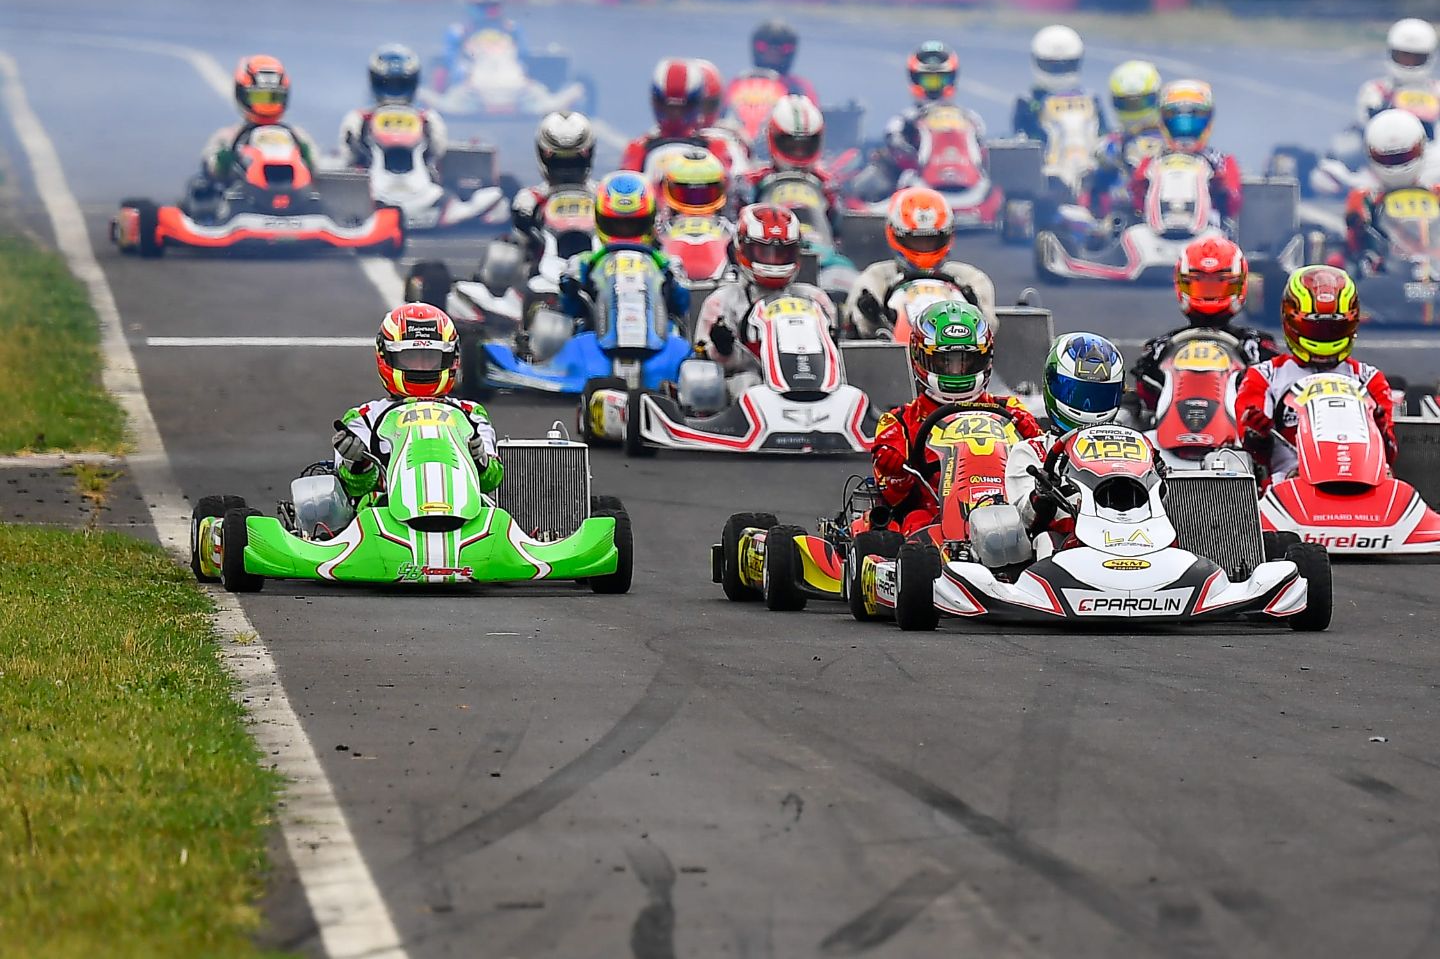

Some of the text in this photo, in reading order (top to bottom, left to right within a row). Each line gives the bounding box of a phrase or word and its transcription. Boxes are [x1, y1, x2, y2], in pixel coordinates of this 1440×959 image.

[944, 325, 967, 334] Arai
[1078, 360, 1108, 378] LA
[1307, 381, 1356, 396] 413
[402, 407, 450, 424] 417
[955, 417, 1006, 439] 426
[1080, 441, 1142, 460] 422
[1312, 514, 1380, 522] RICHARD MILLE
[1304, 533, 1393, 549] birelart
